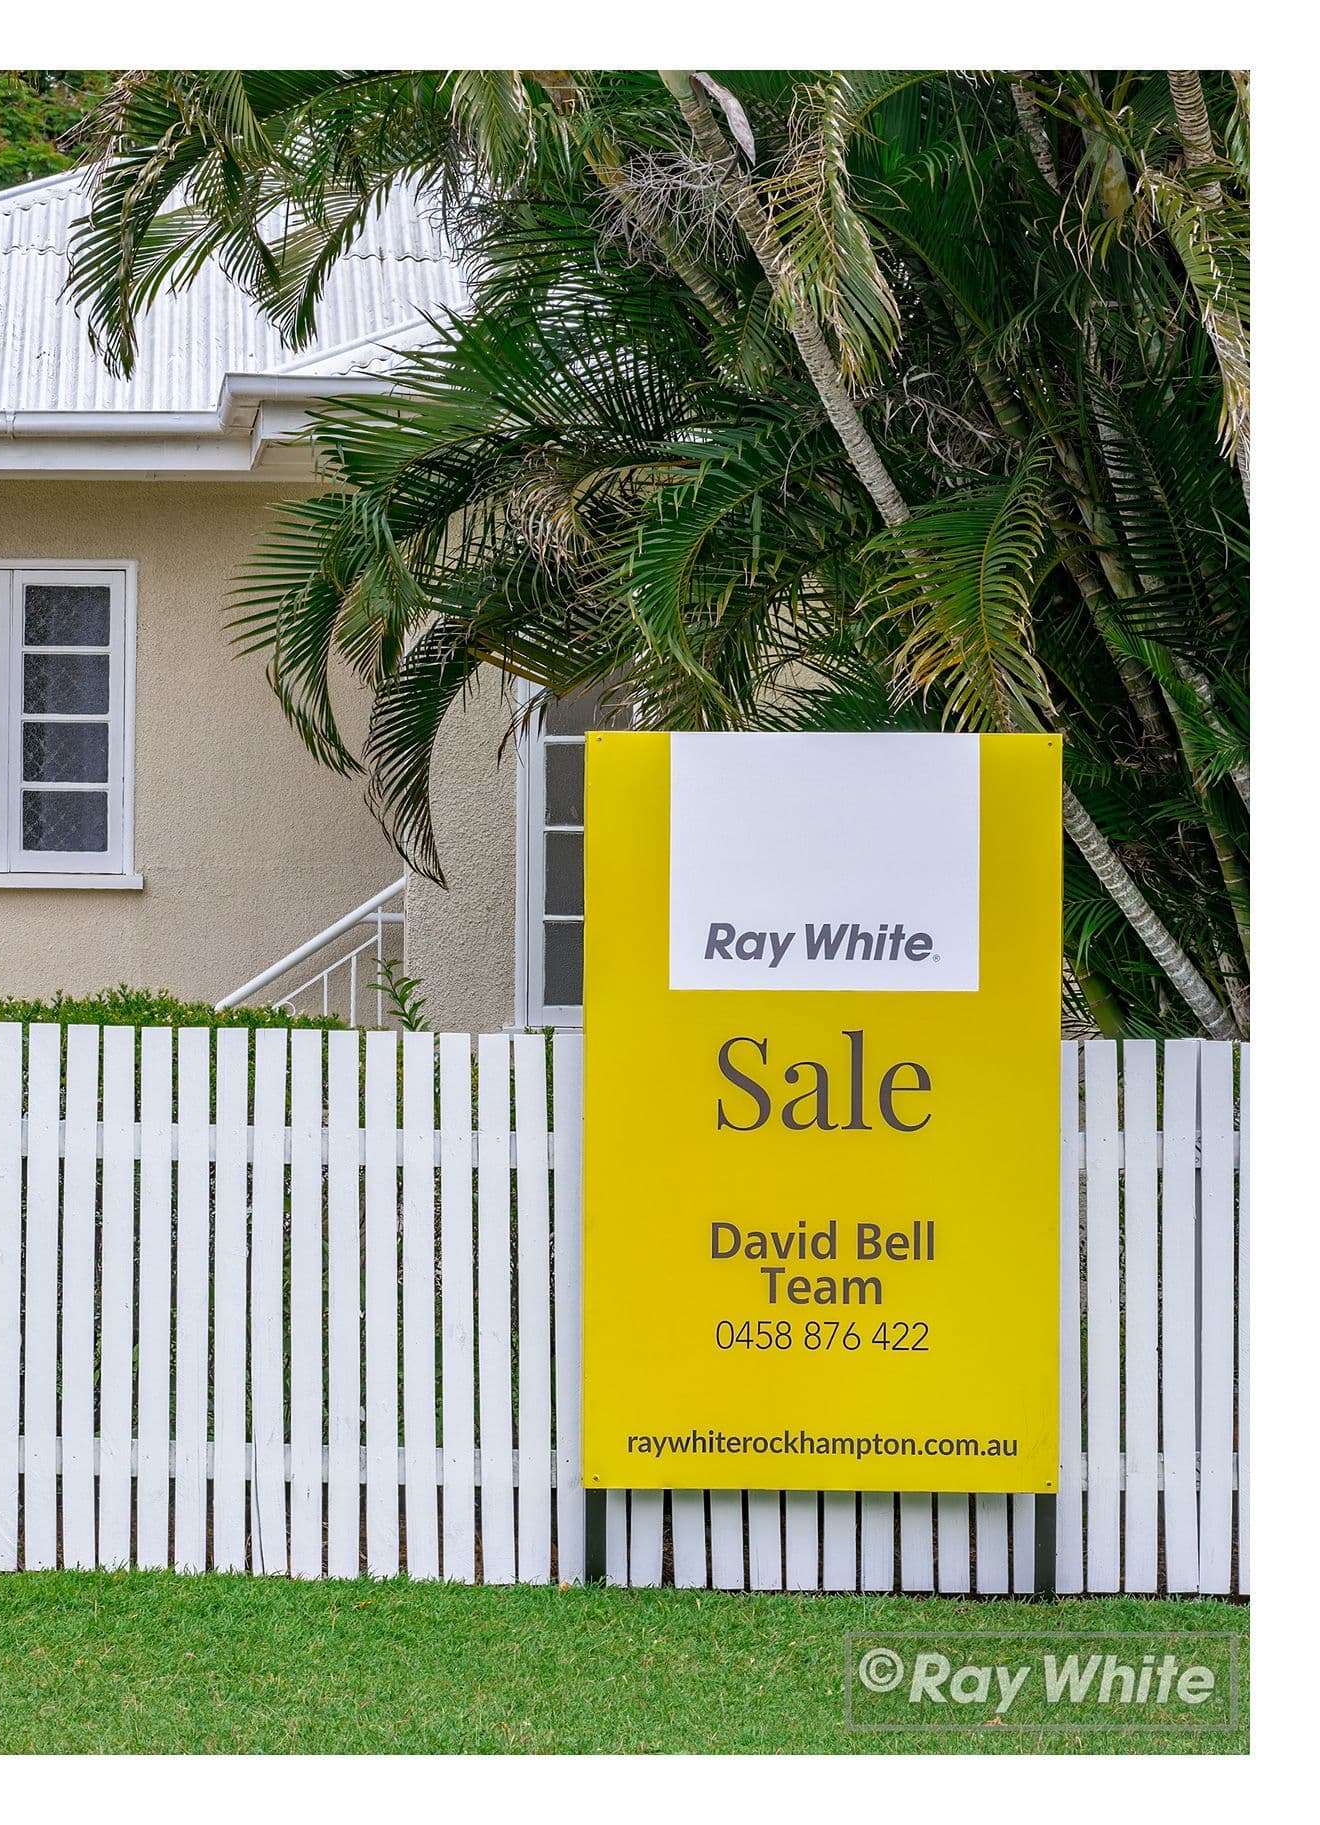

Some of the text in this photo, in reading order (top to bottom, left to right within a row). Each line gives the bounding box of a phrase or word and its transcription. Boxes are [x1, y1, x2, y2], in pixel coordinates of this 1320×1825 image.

[704, 922, 934, 968] Ray White
[716, 1029, 933, 1132] Sale
[710, 1219, 936, 1262] David Bell
[760, 1266, 883, 1305] Team
[715, 1320, 930, 1352] 0458 876 422
[627, 1429, 1019, 1460] raywhiterockhampton.com.au
